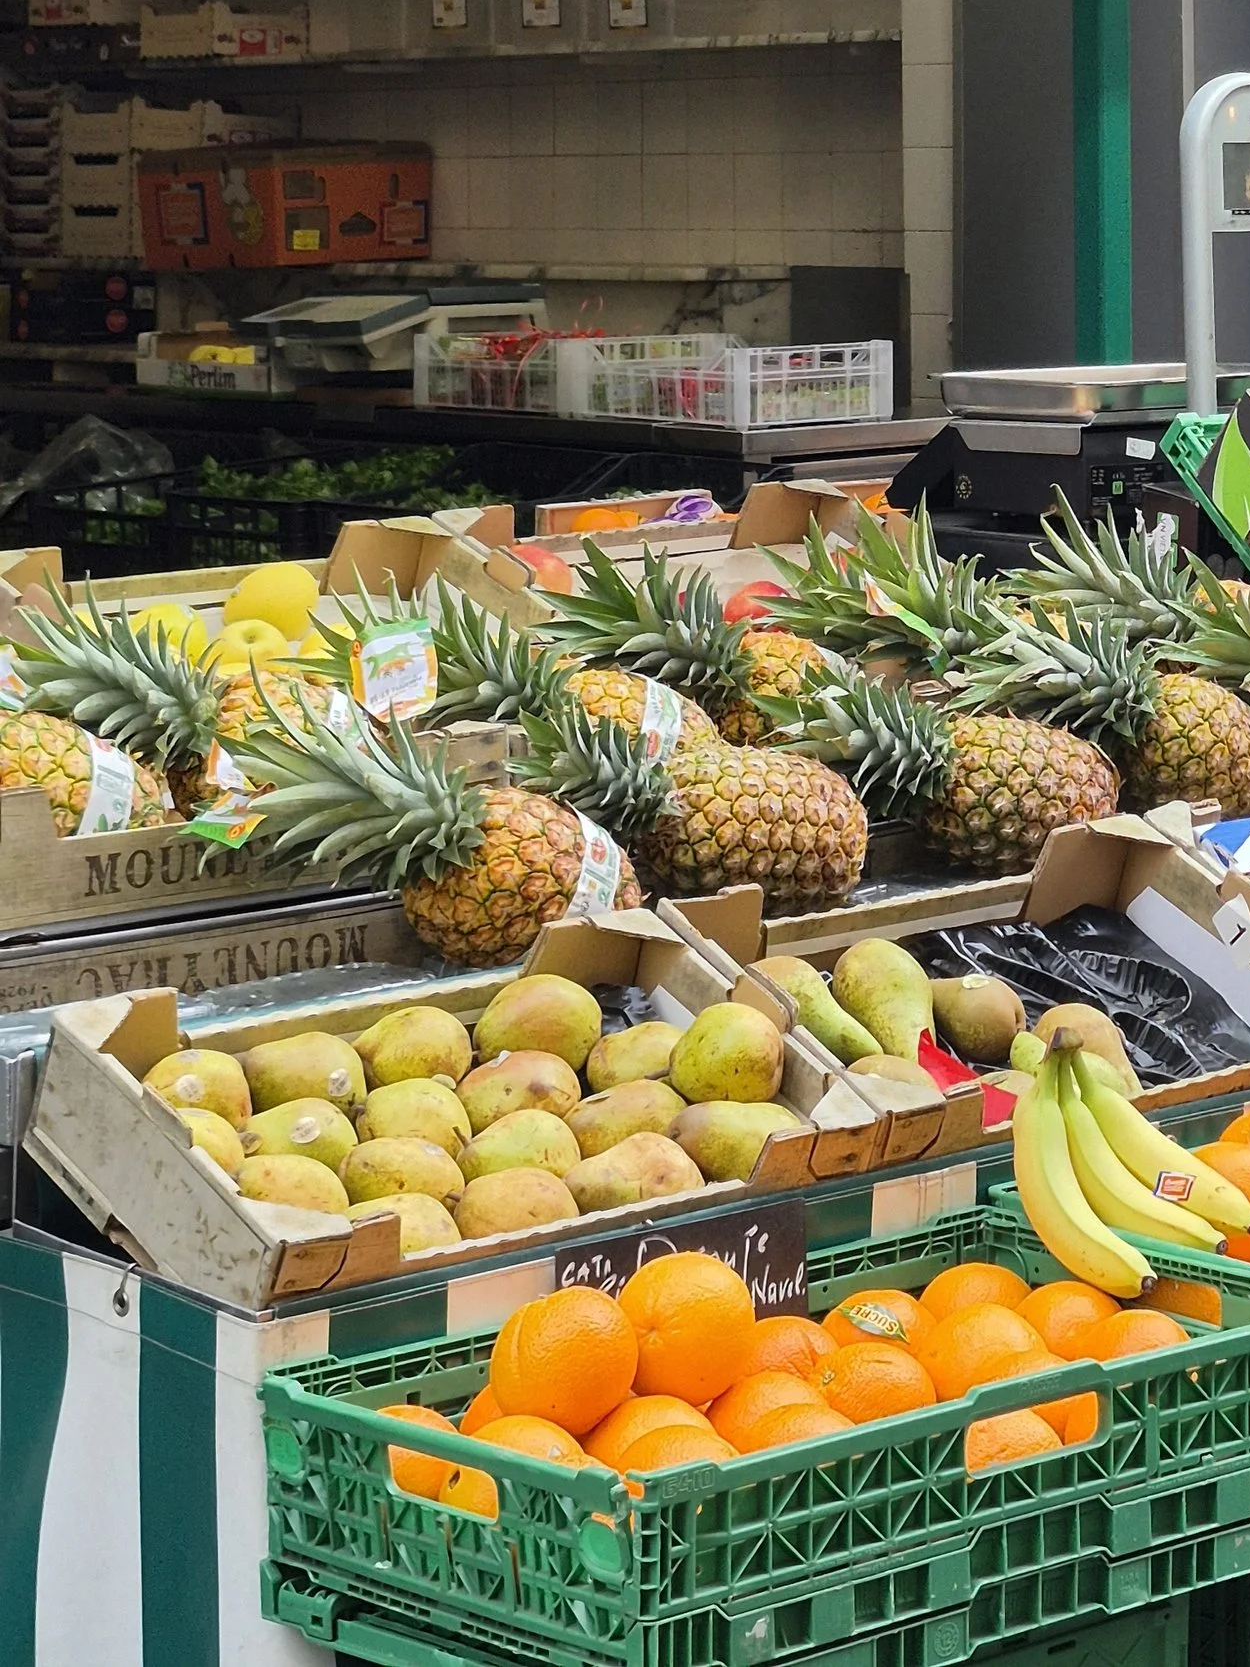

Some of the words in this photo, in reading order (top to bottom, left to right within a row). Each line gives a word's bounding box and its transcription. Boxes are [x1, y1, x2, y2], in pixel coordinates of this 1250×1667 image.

[190, 365, 236, 389] Perlim
[75, 924, 368, 999] MOUNEYRAC
[852, 1305, 898, 1334] SUCRE
